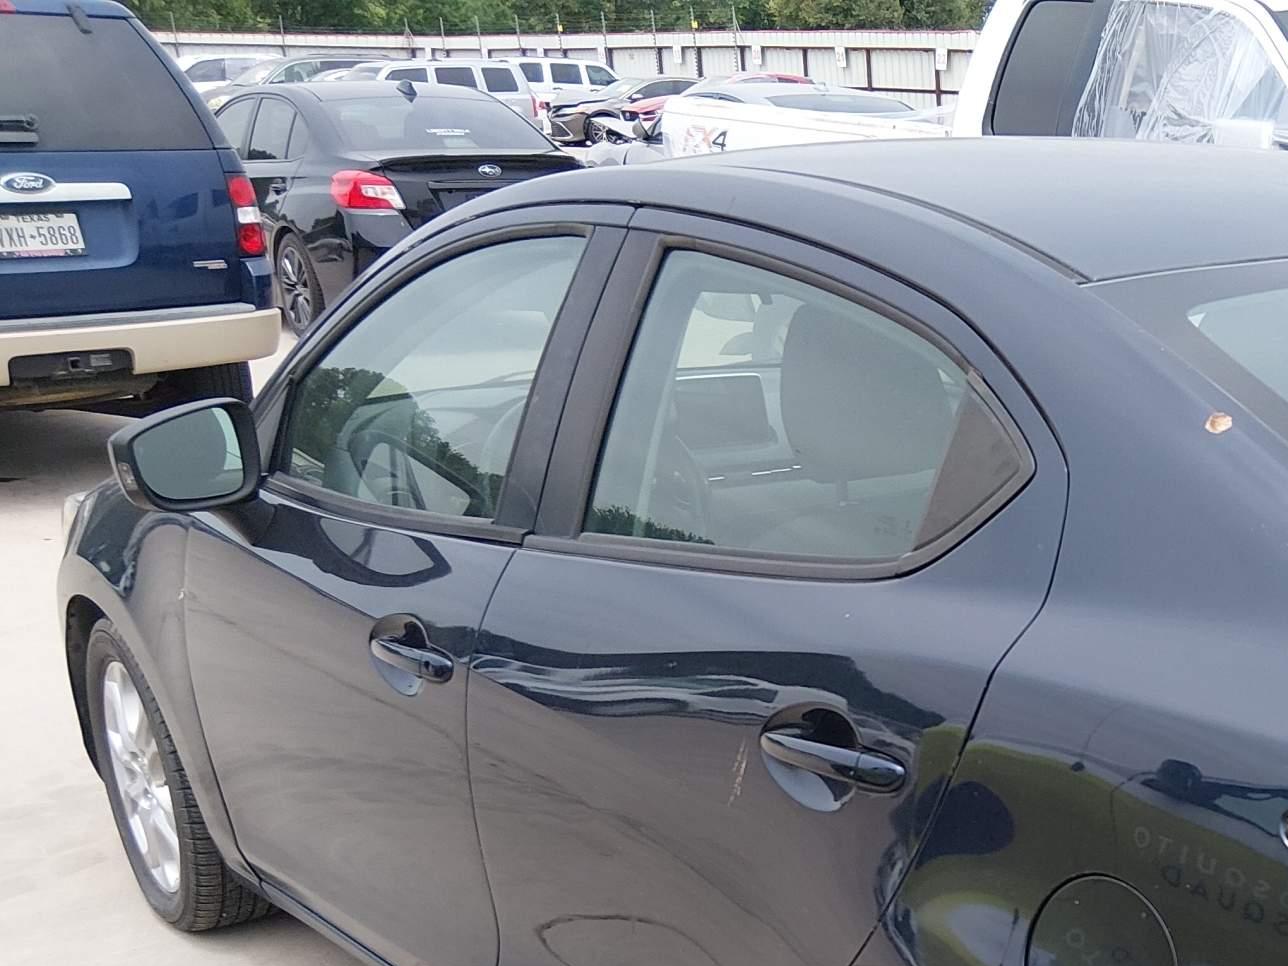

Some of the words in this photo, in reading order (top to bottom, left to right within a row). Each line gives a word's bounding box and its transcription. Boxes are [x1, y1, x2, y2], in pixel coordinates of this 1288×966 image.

[12, 175, 44, 190] Ford
[16, 214, 50, 224] TEXAS
[36, 225, 80, 247] 5868
